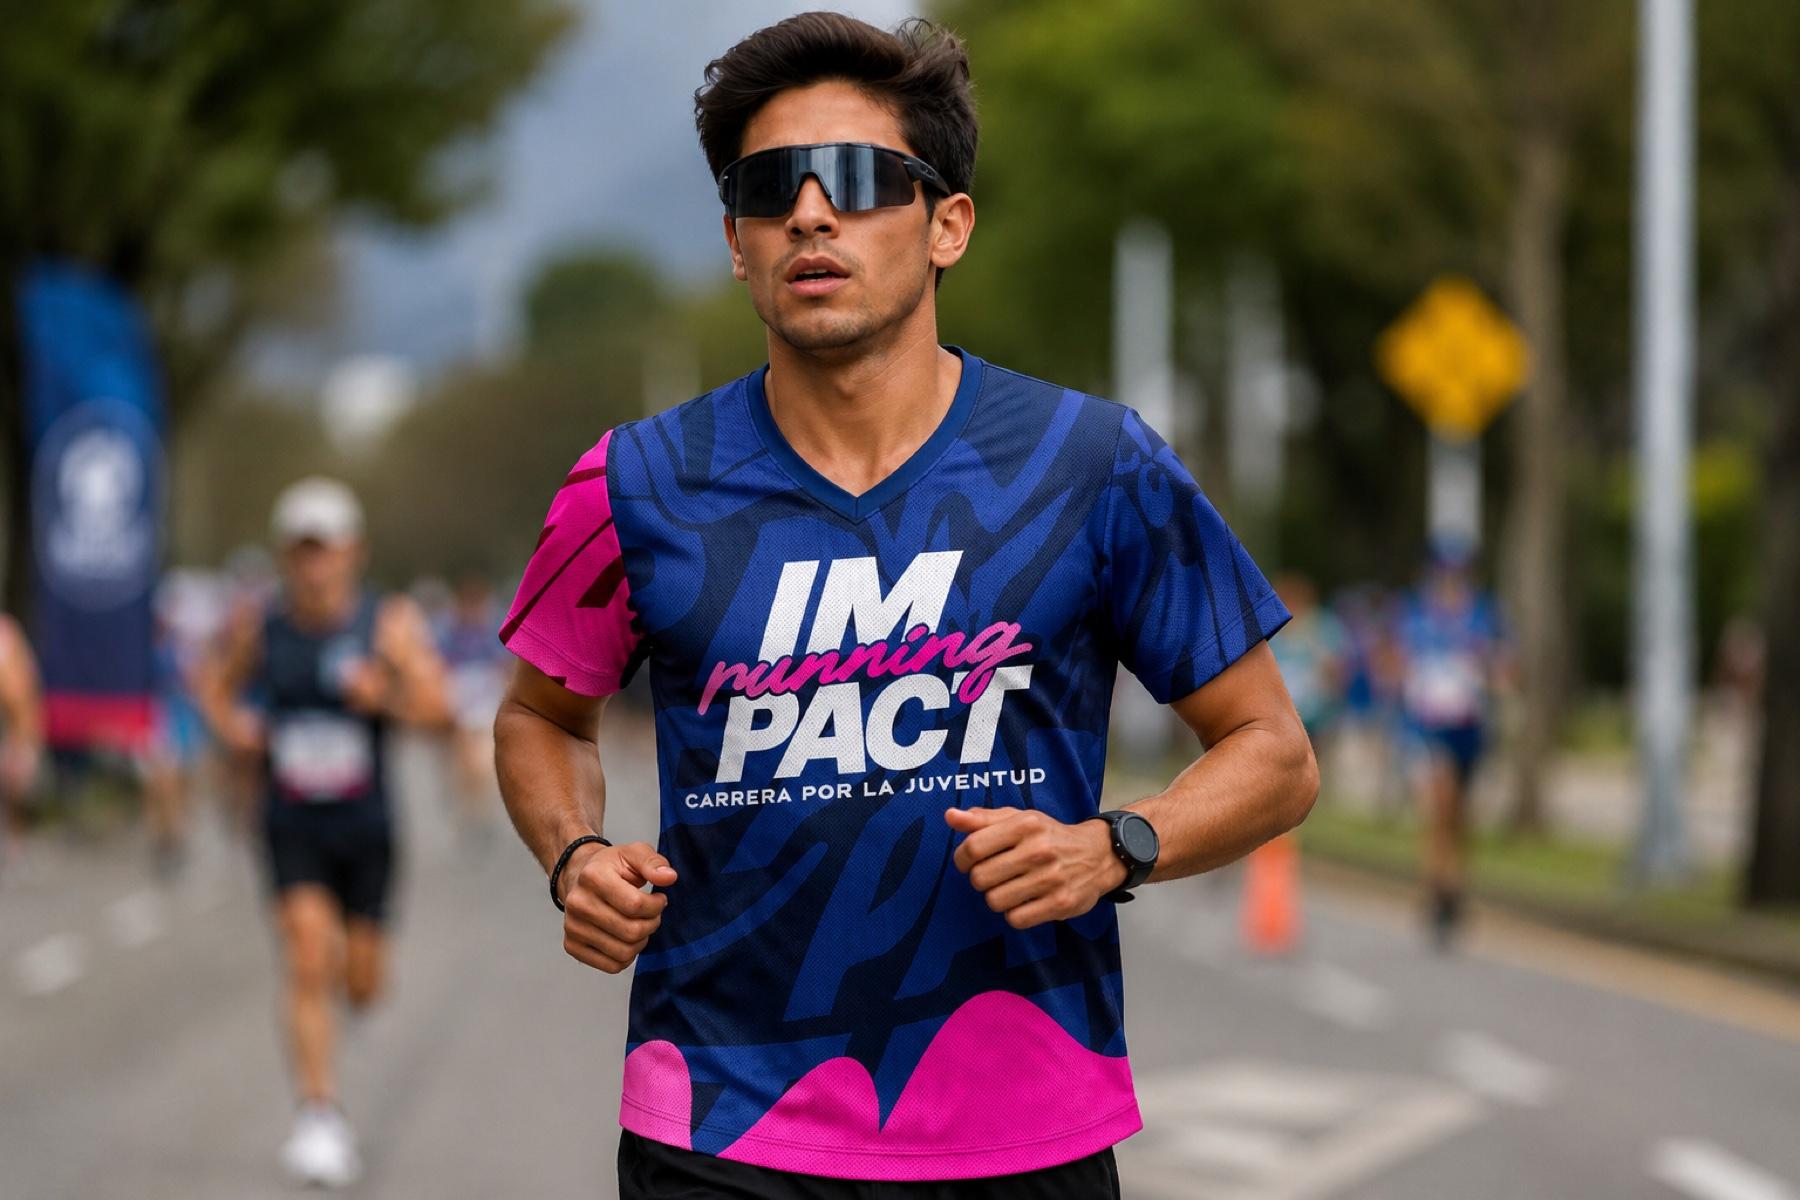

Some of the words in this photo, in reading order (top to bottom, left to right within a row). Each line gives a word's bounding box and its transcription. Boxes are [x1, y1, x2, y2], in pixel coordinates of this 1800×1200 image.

[758, 550, 964, 664] IM
[697, 621, 1033, 716] running
[714, 664, 1034, 784] PACT
[685, 788, 792, 810] CARRERA
[802, 783, 852, 801] POR
[863, 780, 895, 797] LA
[905, 767, 1046, 794] JUVENTUD
